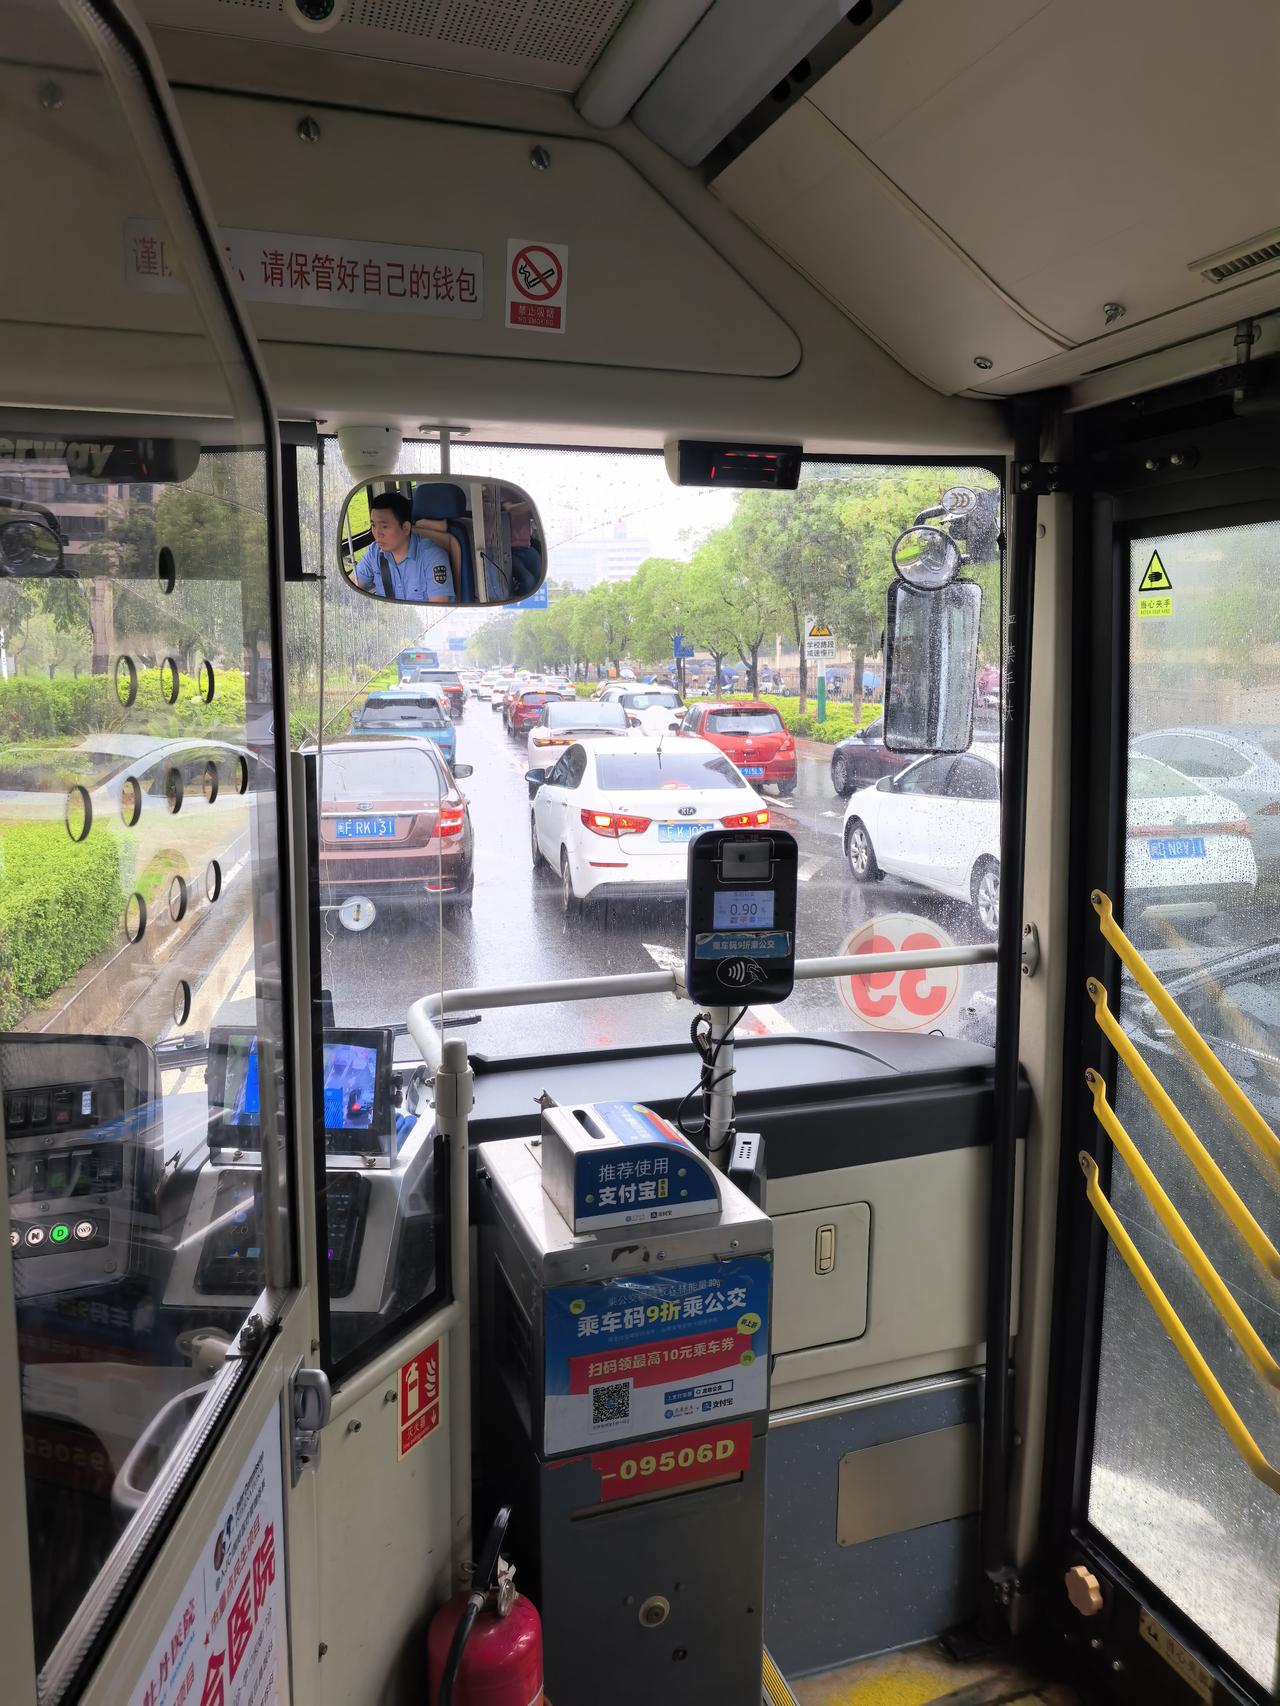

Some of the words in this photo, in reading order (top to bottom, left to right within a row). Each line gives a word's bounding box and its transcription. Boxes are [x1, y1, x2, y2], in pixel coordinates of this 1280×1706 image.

[806, 641, 835, 649] 学校路段
[806, 649, 834, 657] 减速慢行
[730, 903, 757, 916] 0.90
[599, 1157, 669, 1183] 推荐使用
[598, 1182, 657, 1207] 支付宝
[577, 1287, 747, 1338] 乘车码9折乘公交
[588, 1337, 735, 1378] 扫码领最高10元乘车券
[713, 1398, 733, 1409] 支付宝
[620, 1439, 735, 1480] 09506D
